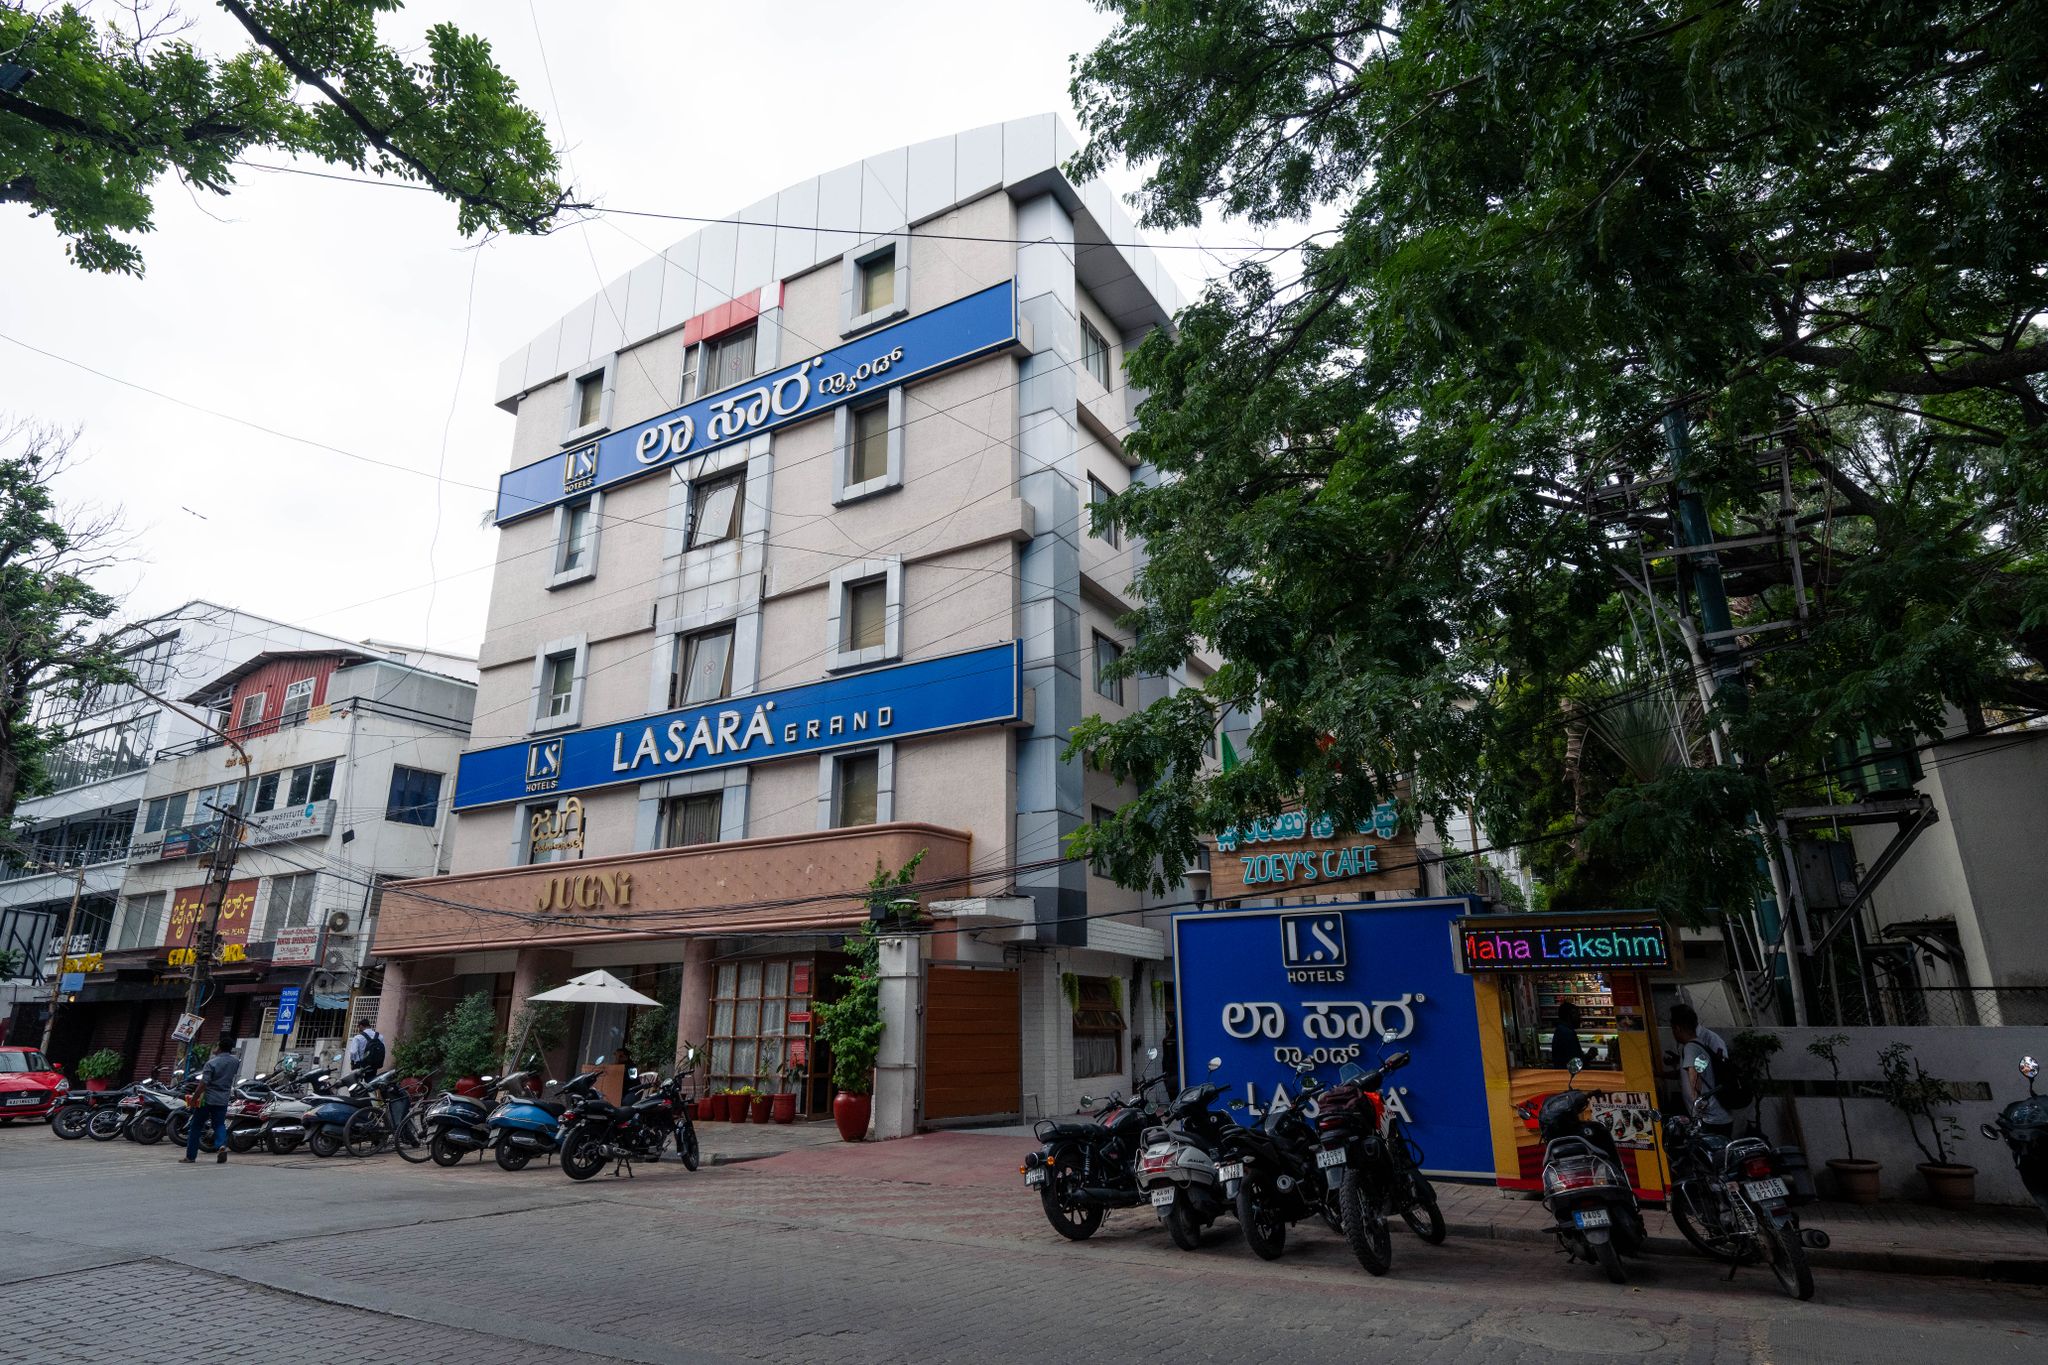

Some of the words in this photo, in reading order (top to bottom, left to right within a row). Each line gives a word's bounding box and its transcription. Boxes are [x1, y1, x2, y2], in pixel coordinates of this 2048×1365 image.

[636, 414, 695, 465] ಲಾ
[563, 478, 593, 494] HOTELS
[784, 706, 893, 743] GRAND
[525, 780, 558, 793] HOTELS
[1240, 850, 1318, 885] ZOEY'S
[1322, 845, 1379, 878] CAFE
[1541, 932, 1661, 959] Lakshm
[1287, 970, 1345, 983] HOTELS
[1222, 1002, 1285, 1039] ಲಾ
